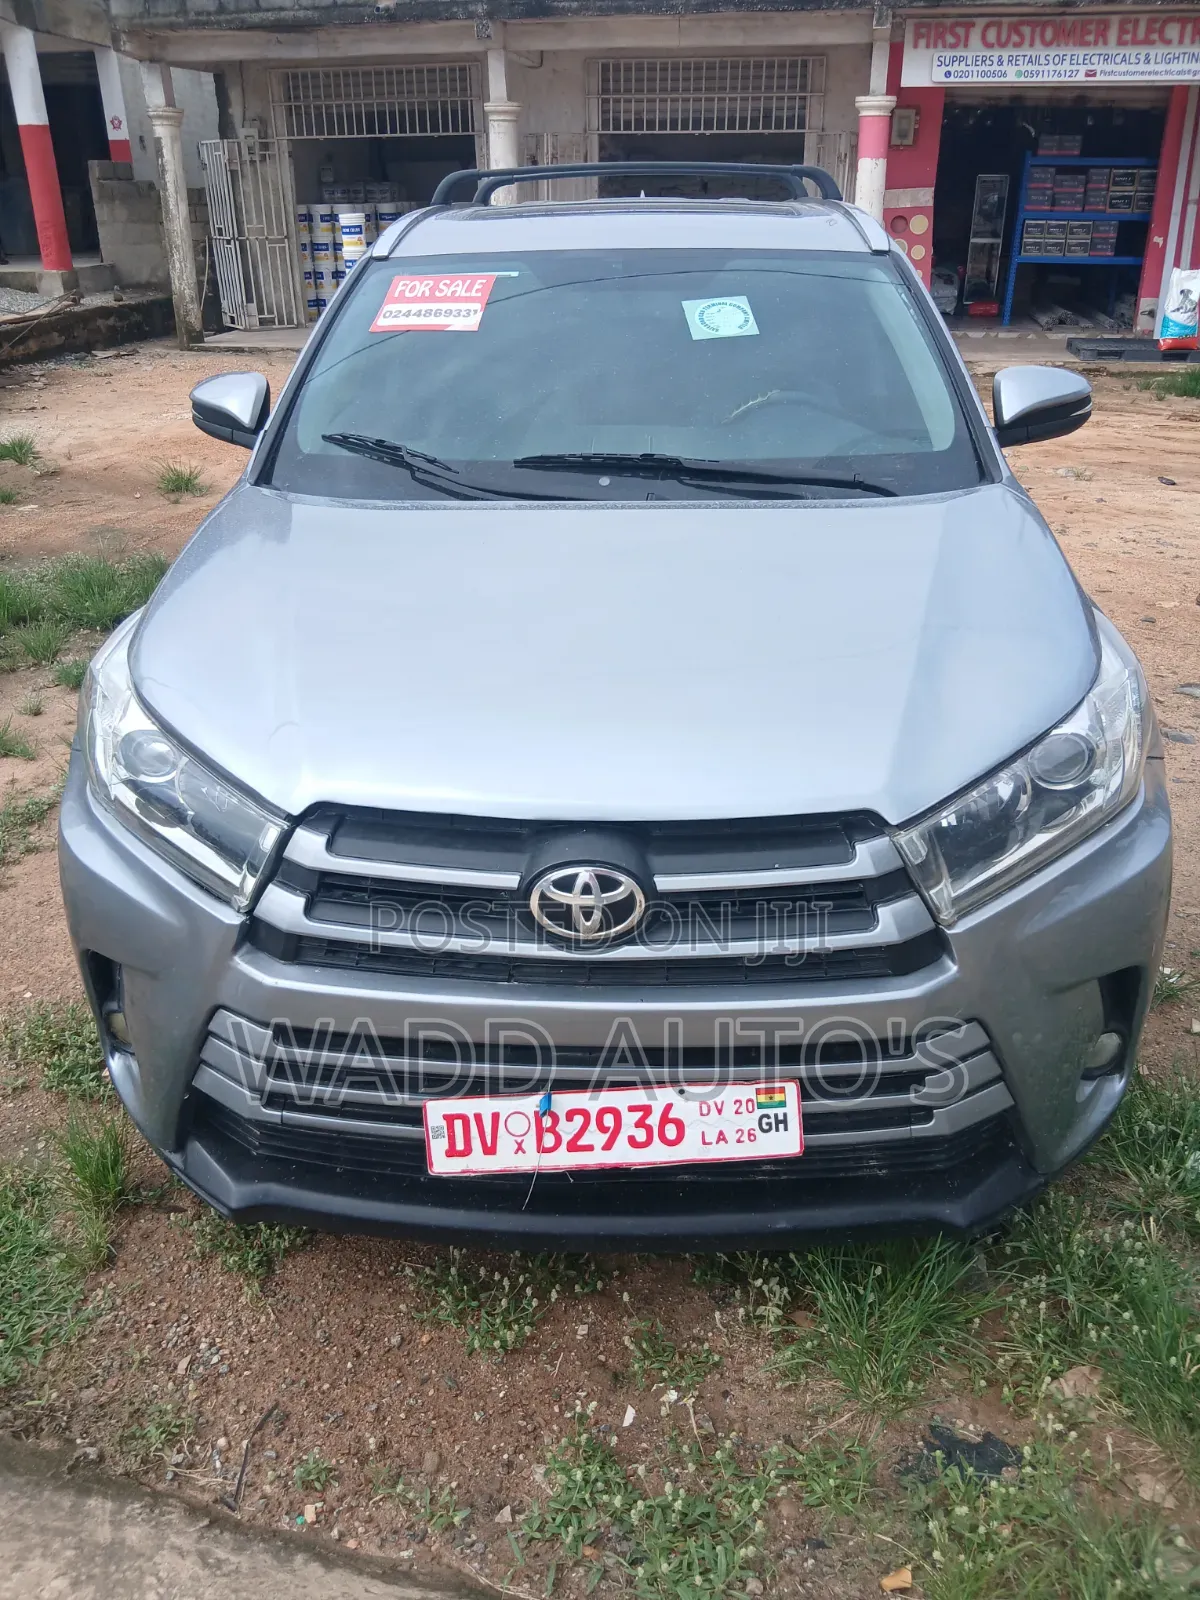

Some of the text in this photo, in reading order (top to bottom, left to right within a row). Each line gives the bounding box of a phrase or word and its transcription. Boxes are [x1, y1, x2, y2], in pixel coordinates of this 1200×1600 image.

[912, 20, 976, 49] FIRST
[981, 17, 1110, 49] CUSTOMER
[936, 51, 1200, 68] SUPPLIERS & RETAILS OF ELECTRICALS & LIGHTIN
[953, 69, 1008, 79] 0201100506
[1023, 68, 1080, 79] 0591176127
[394, 279, 487, 298] FOR SALE
[699, 1097, 756, 1117] DV 20
[442, 1101, 686, 1158] DV B2936
[757, 1112, 789, 1134] GH
[701, 1127, 757, 1146] LA 26
